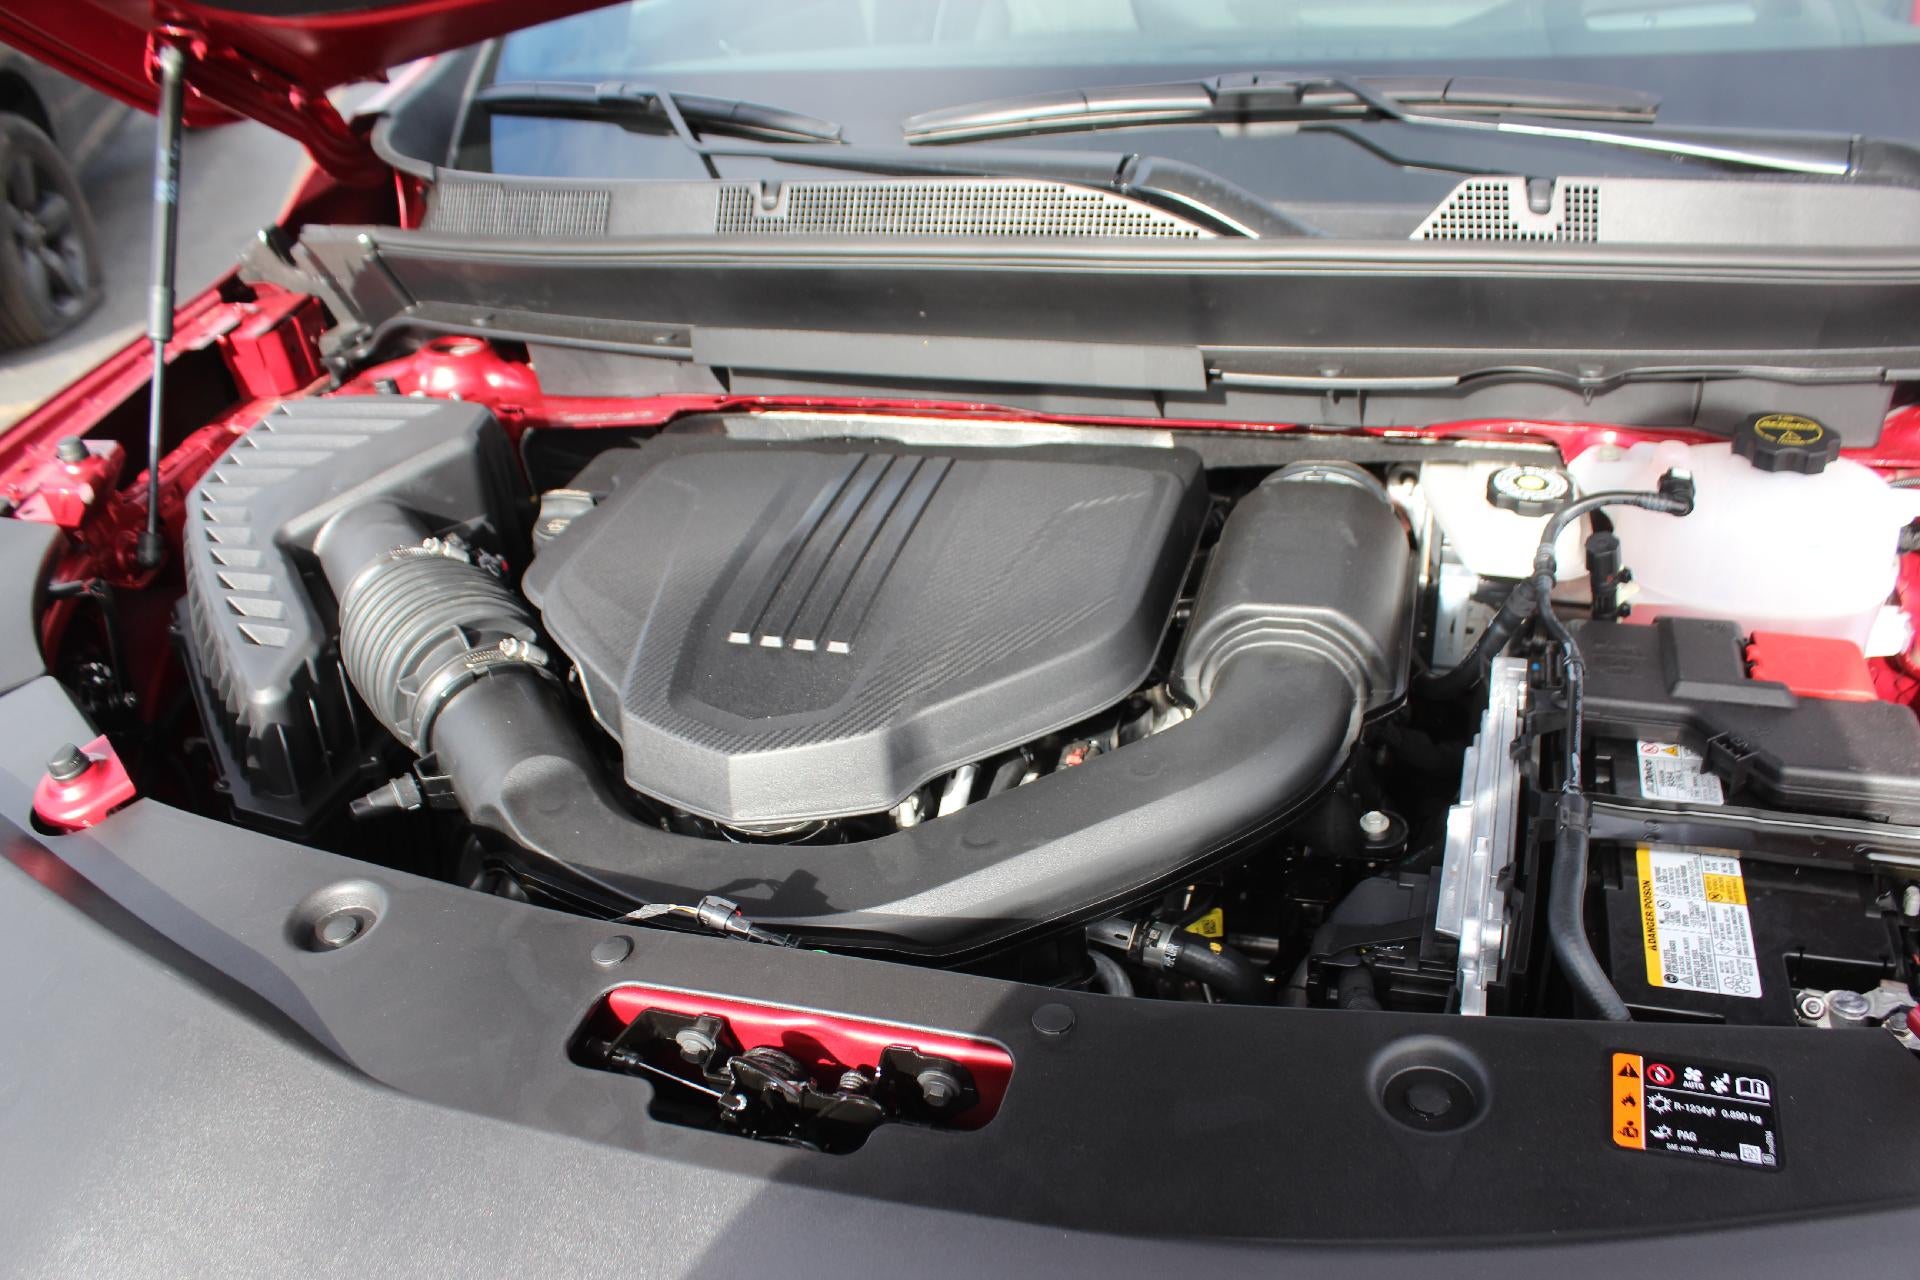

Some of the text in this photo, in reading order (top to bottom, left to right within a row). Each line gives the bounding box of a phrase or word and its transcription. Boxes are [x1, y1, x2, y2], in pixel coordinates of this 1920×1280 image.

[1642, 880, 1657, 944] DANGER POISON
[1682, 1080, 1705, 1091] AUTO
[1749, 1112, 1763, 1126] kg
[1676, 1129, 1698, 1143] PAG
